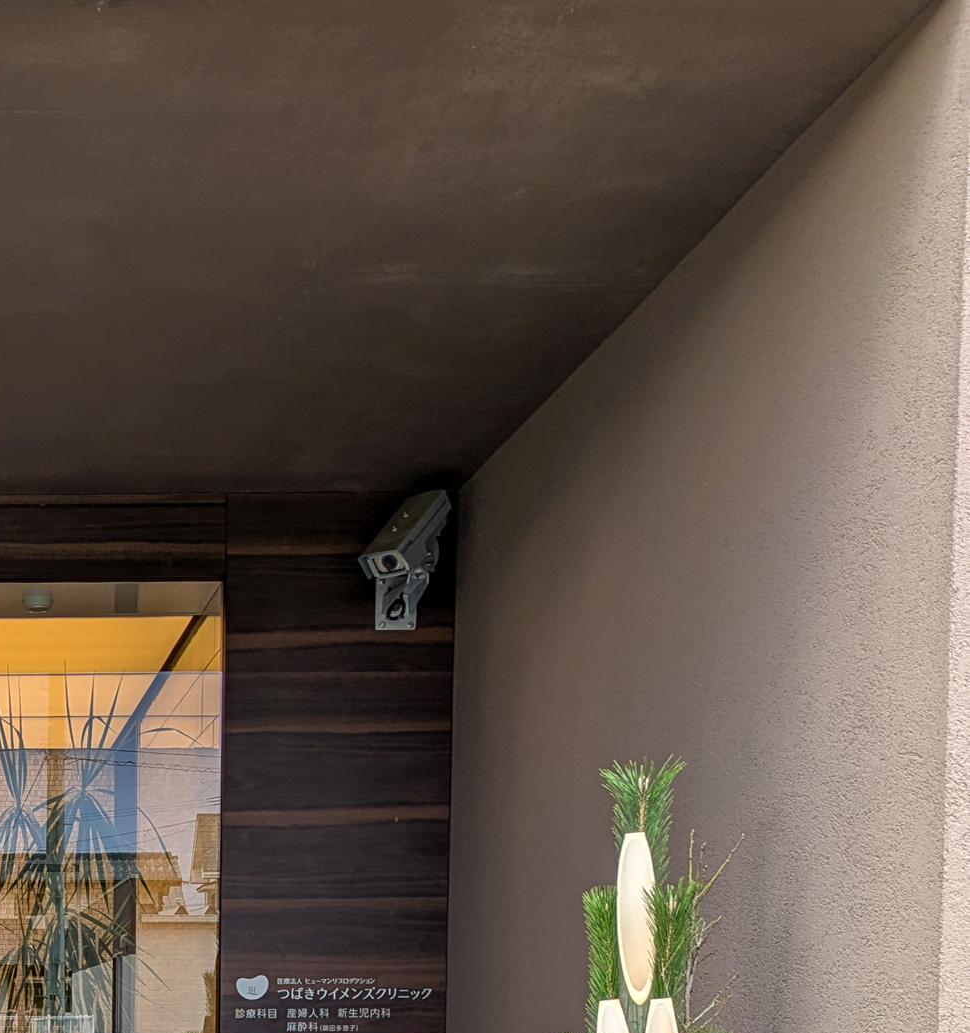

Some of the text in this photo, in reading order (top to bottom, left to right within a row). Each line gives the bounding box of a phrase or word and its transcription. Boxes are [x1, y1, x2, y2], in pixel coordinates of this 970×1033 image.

[277, 987, 432, 1000] つばきウイメンズクリニック
[235, 1008, 391, 1019] 診療科目 産婦人科 新生児内科
